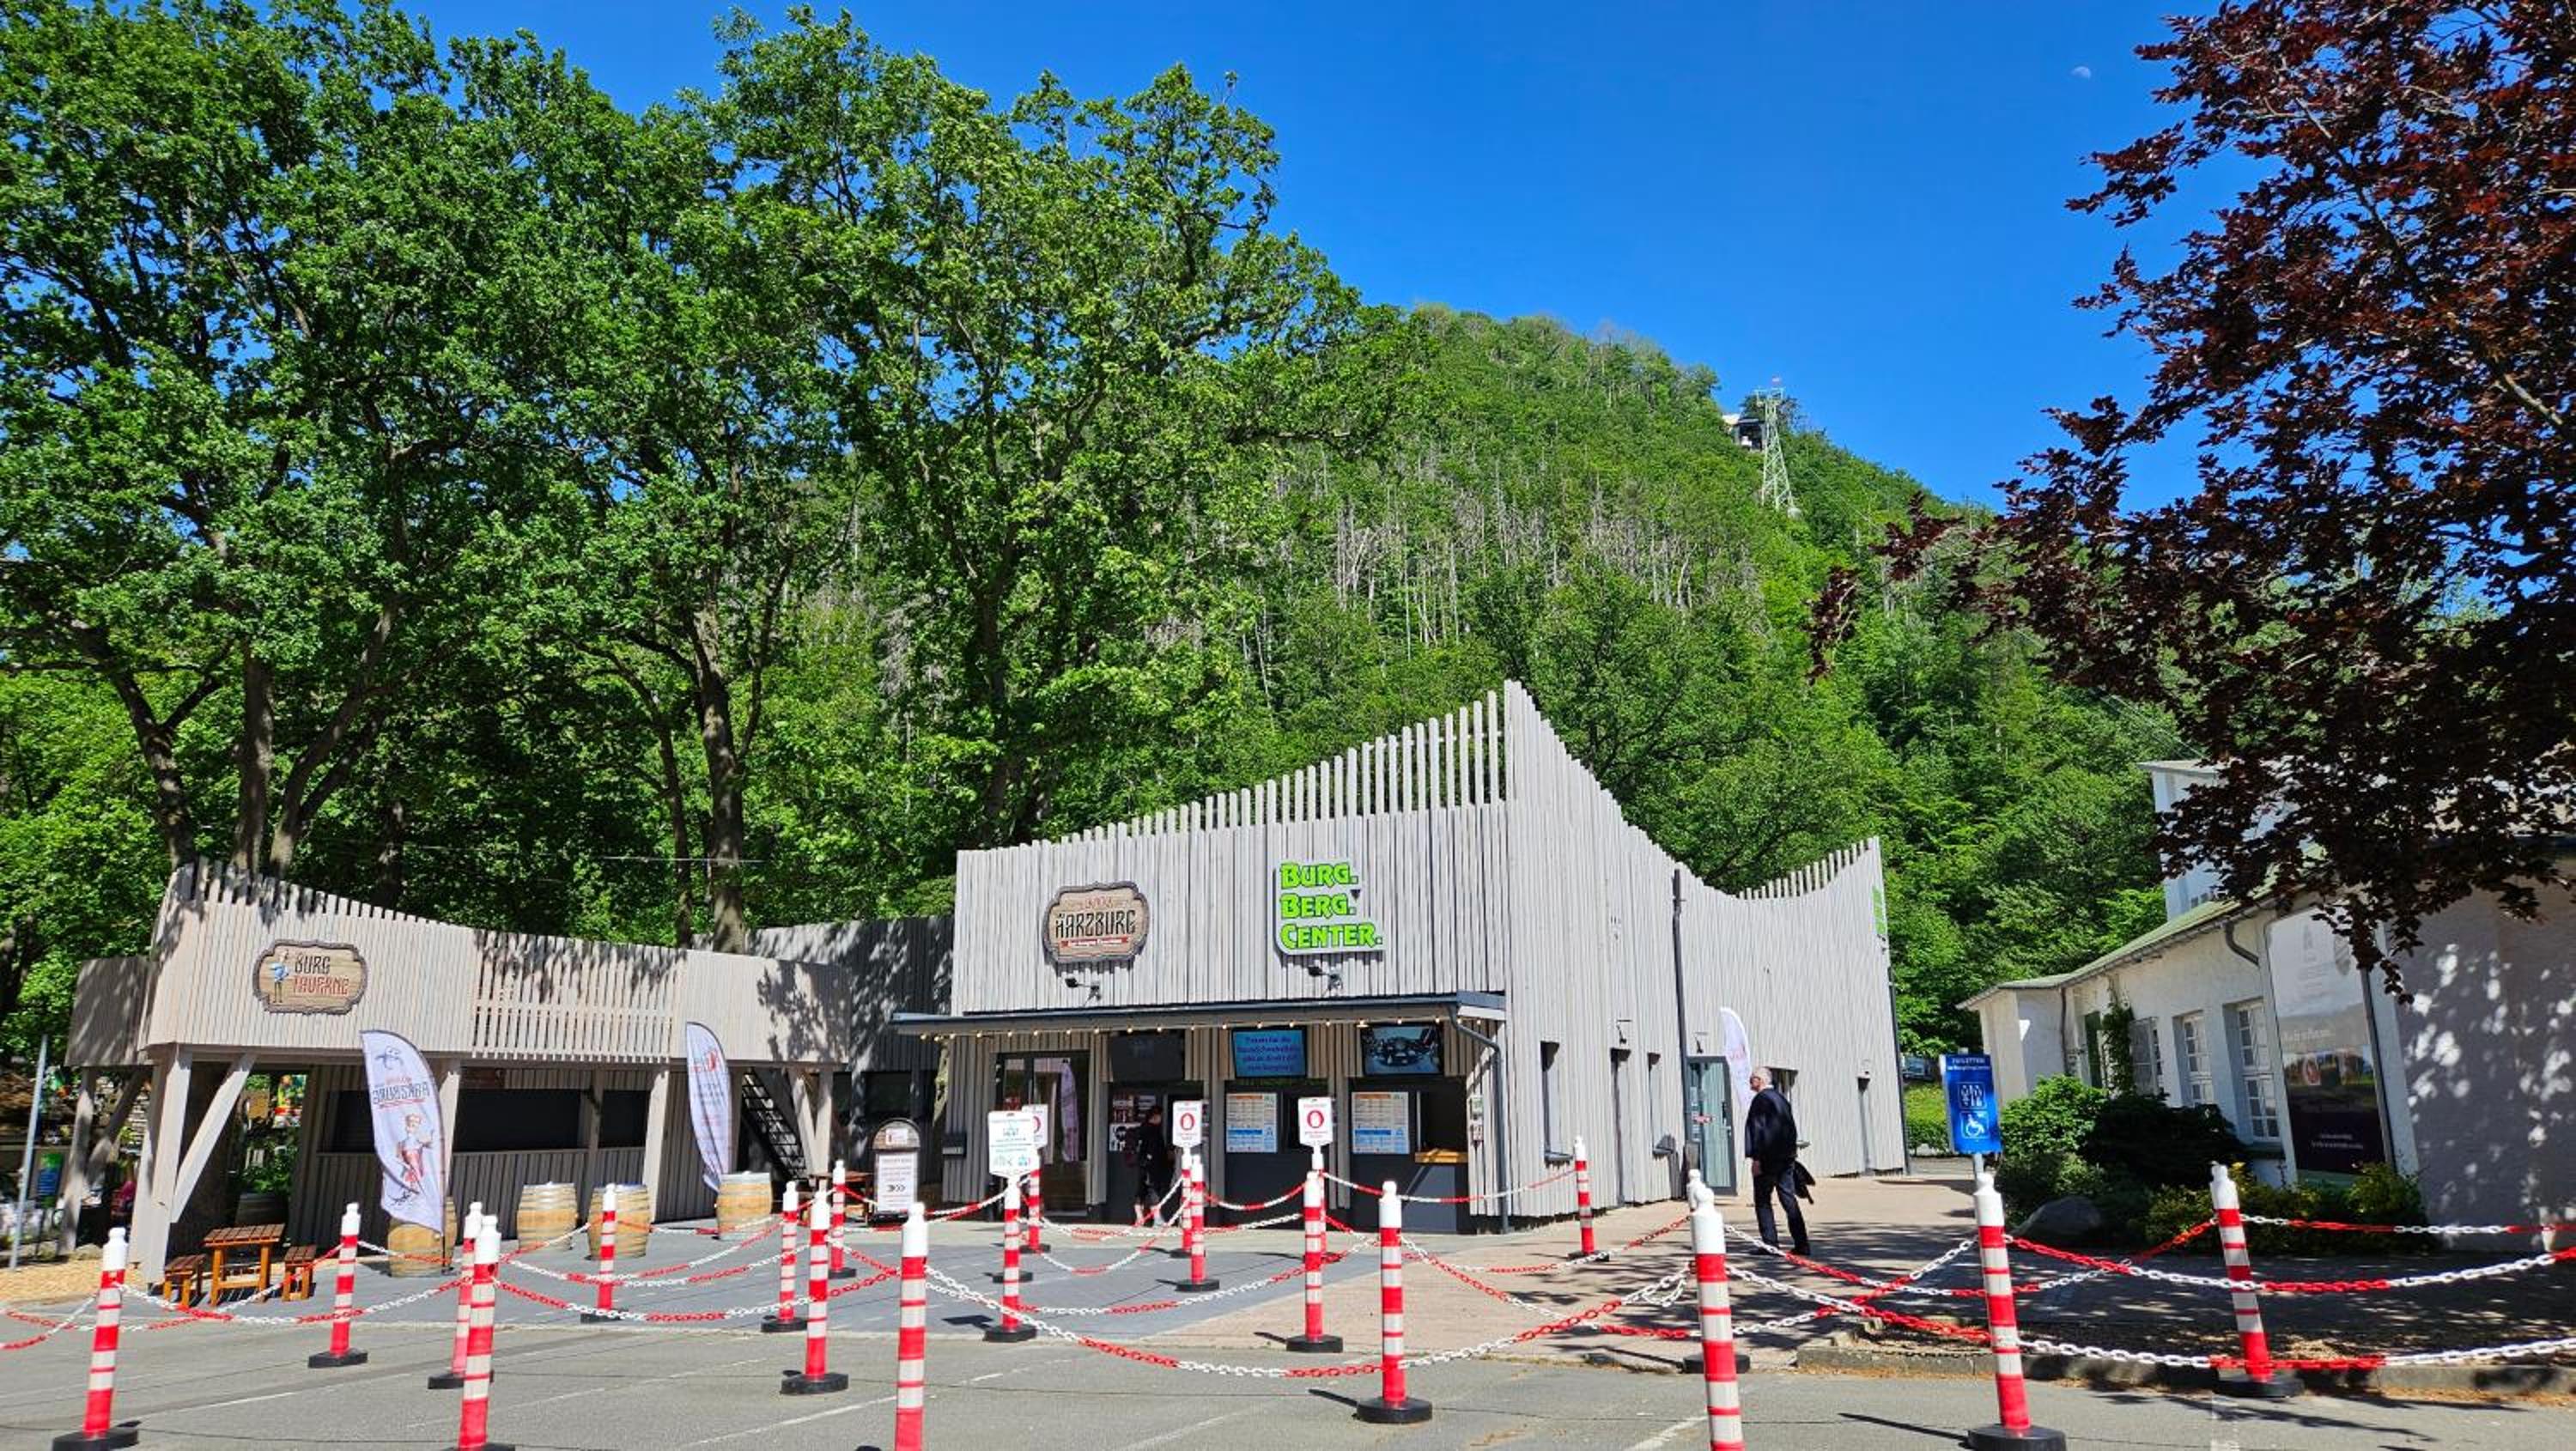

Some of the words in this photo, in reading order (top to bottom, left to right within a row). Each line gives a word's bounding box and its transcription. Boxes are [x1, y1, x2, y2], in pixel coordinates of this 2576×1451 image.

[1279, 861, 1359, 889] BURG.
[1279, 893, 1357, 919] BERG.
[1280, 923, 1382, 950] CENTER.
[294, 953, 331, 974] BURG
